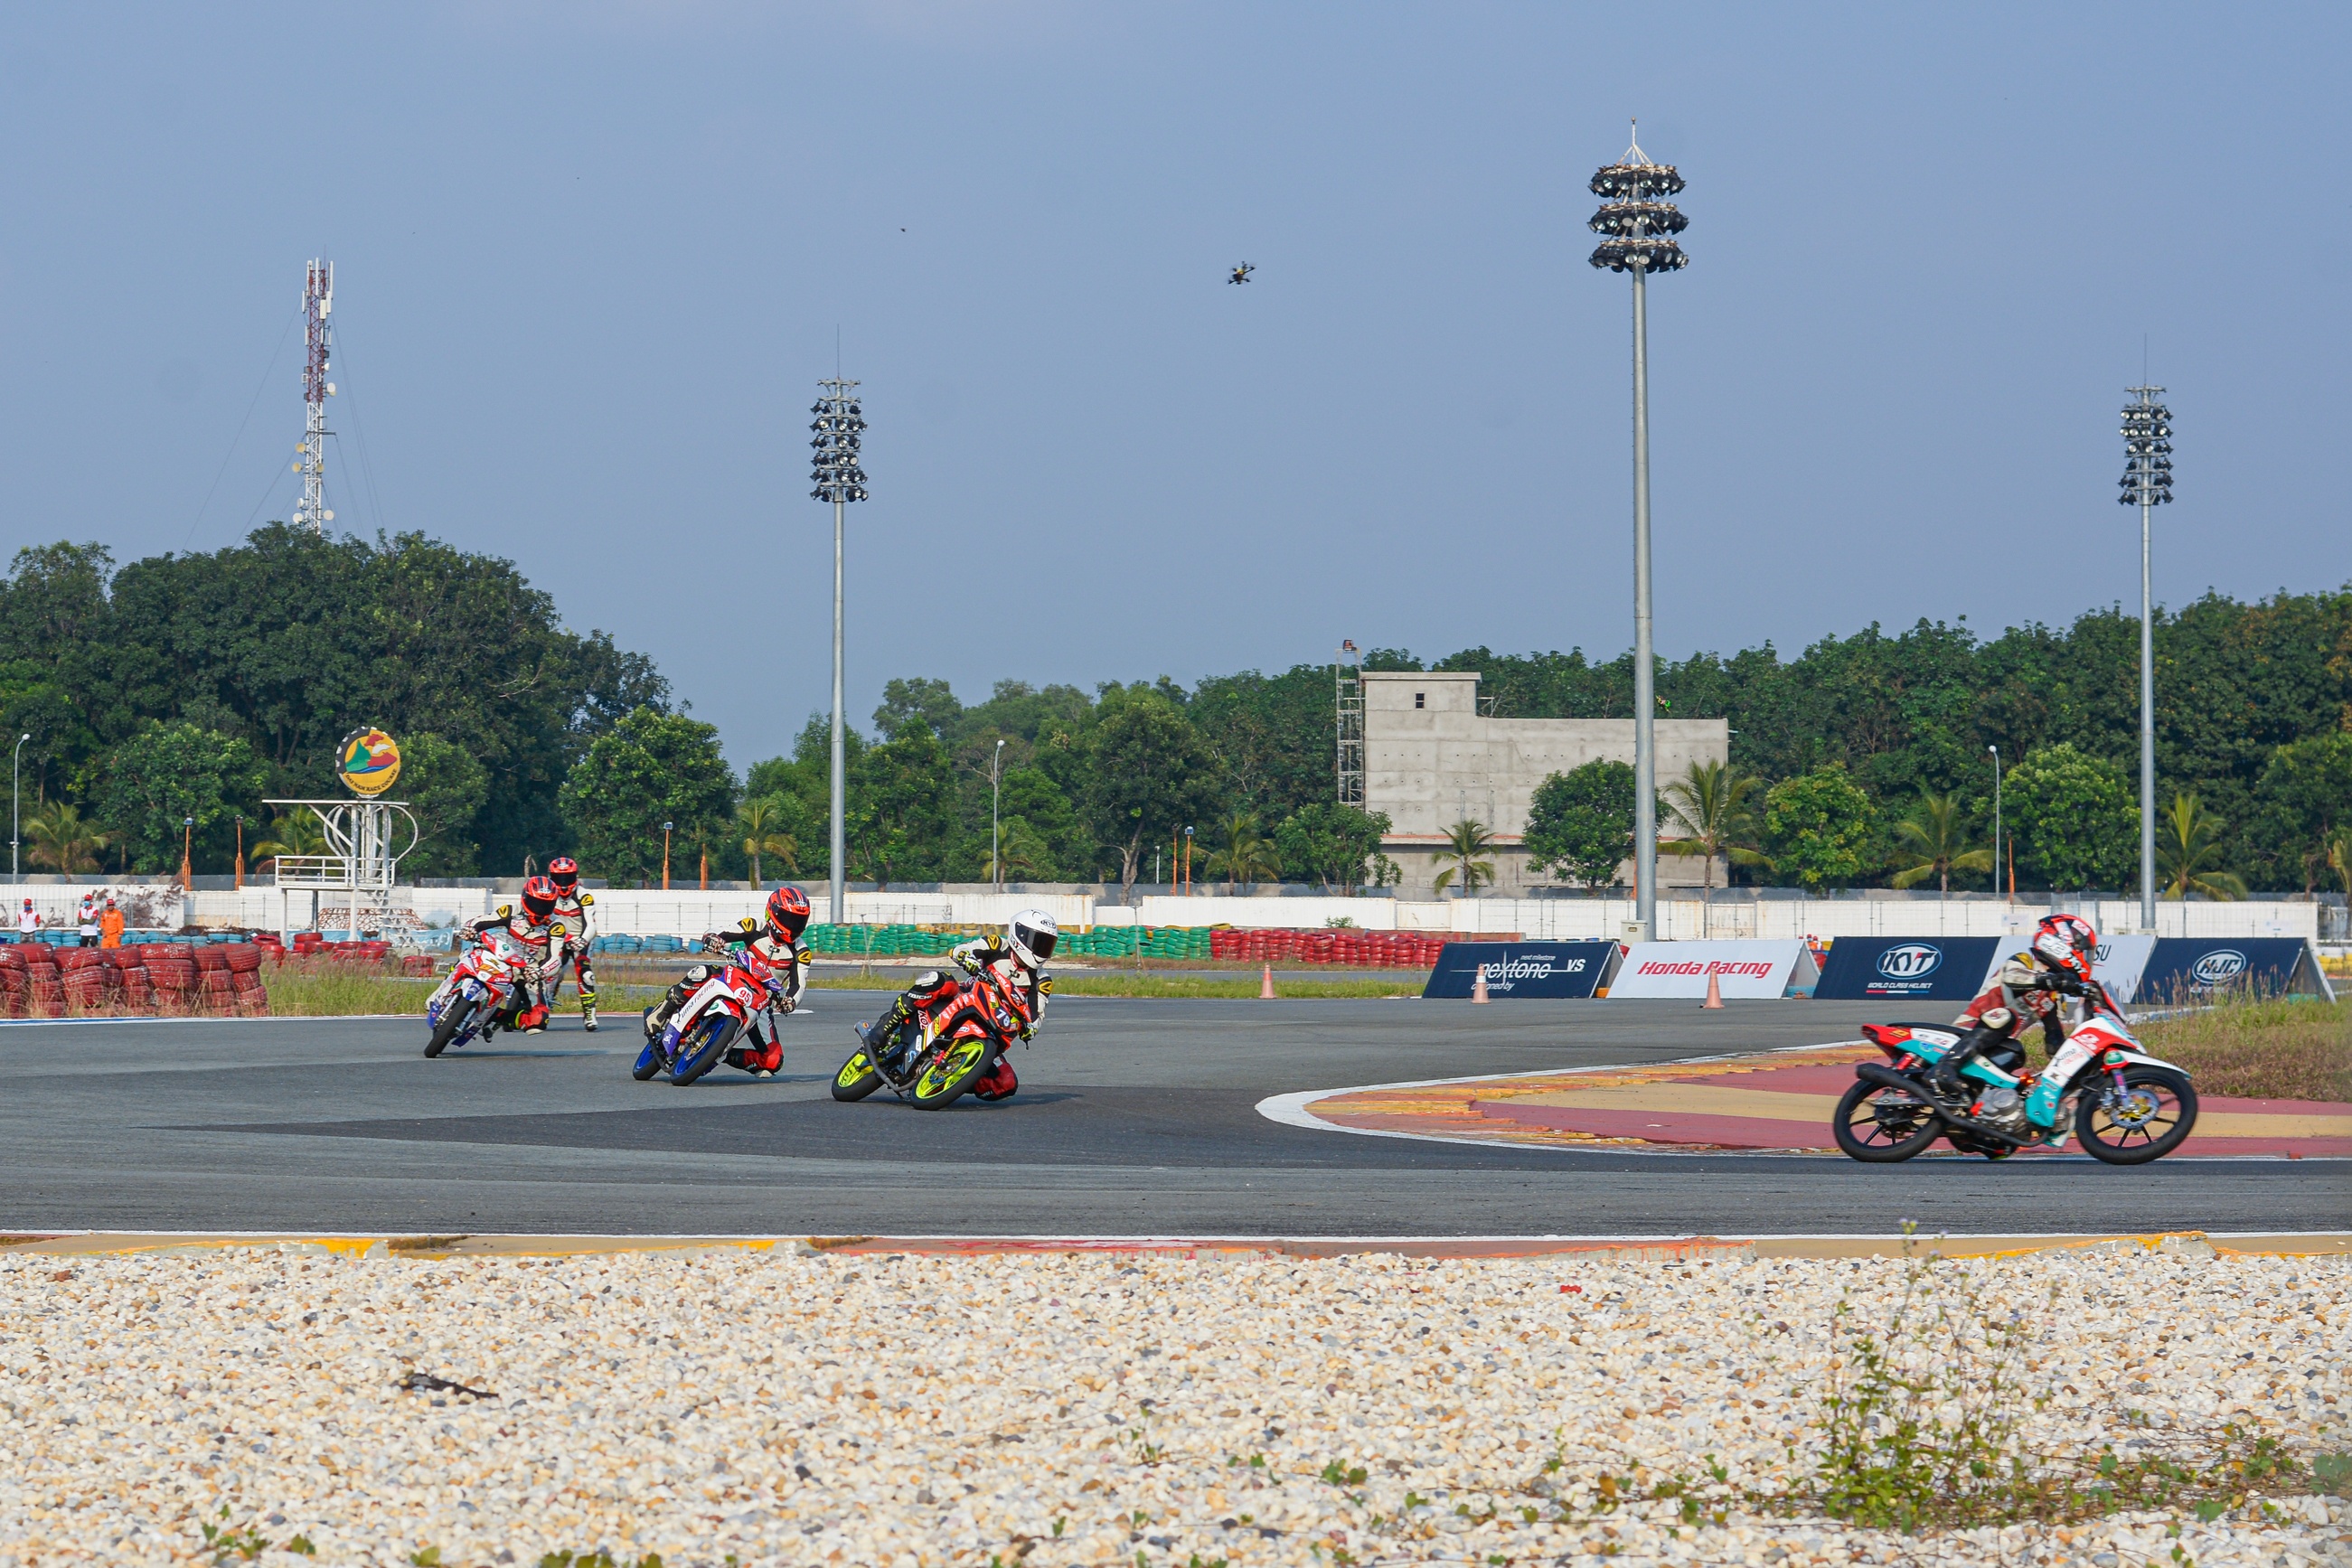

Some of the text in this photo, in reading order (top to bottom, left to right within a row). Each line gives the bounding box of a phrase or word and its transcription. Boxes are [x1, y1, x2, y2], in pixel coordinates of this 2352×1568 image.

[1637, 961, 1773, 979] Honda Racing
[1883, 952, 1936, 972] KYT
[2198, 959, 2240, 973] HJC
[739, 990, 752, 1003] 95
[995, 1009, 1011, 1027] 78
